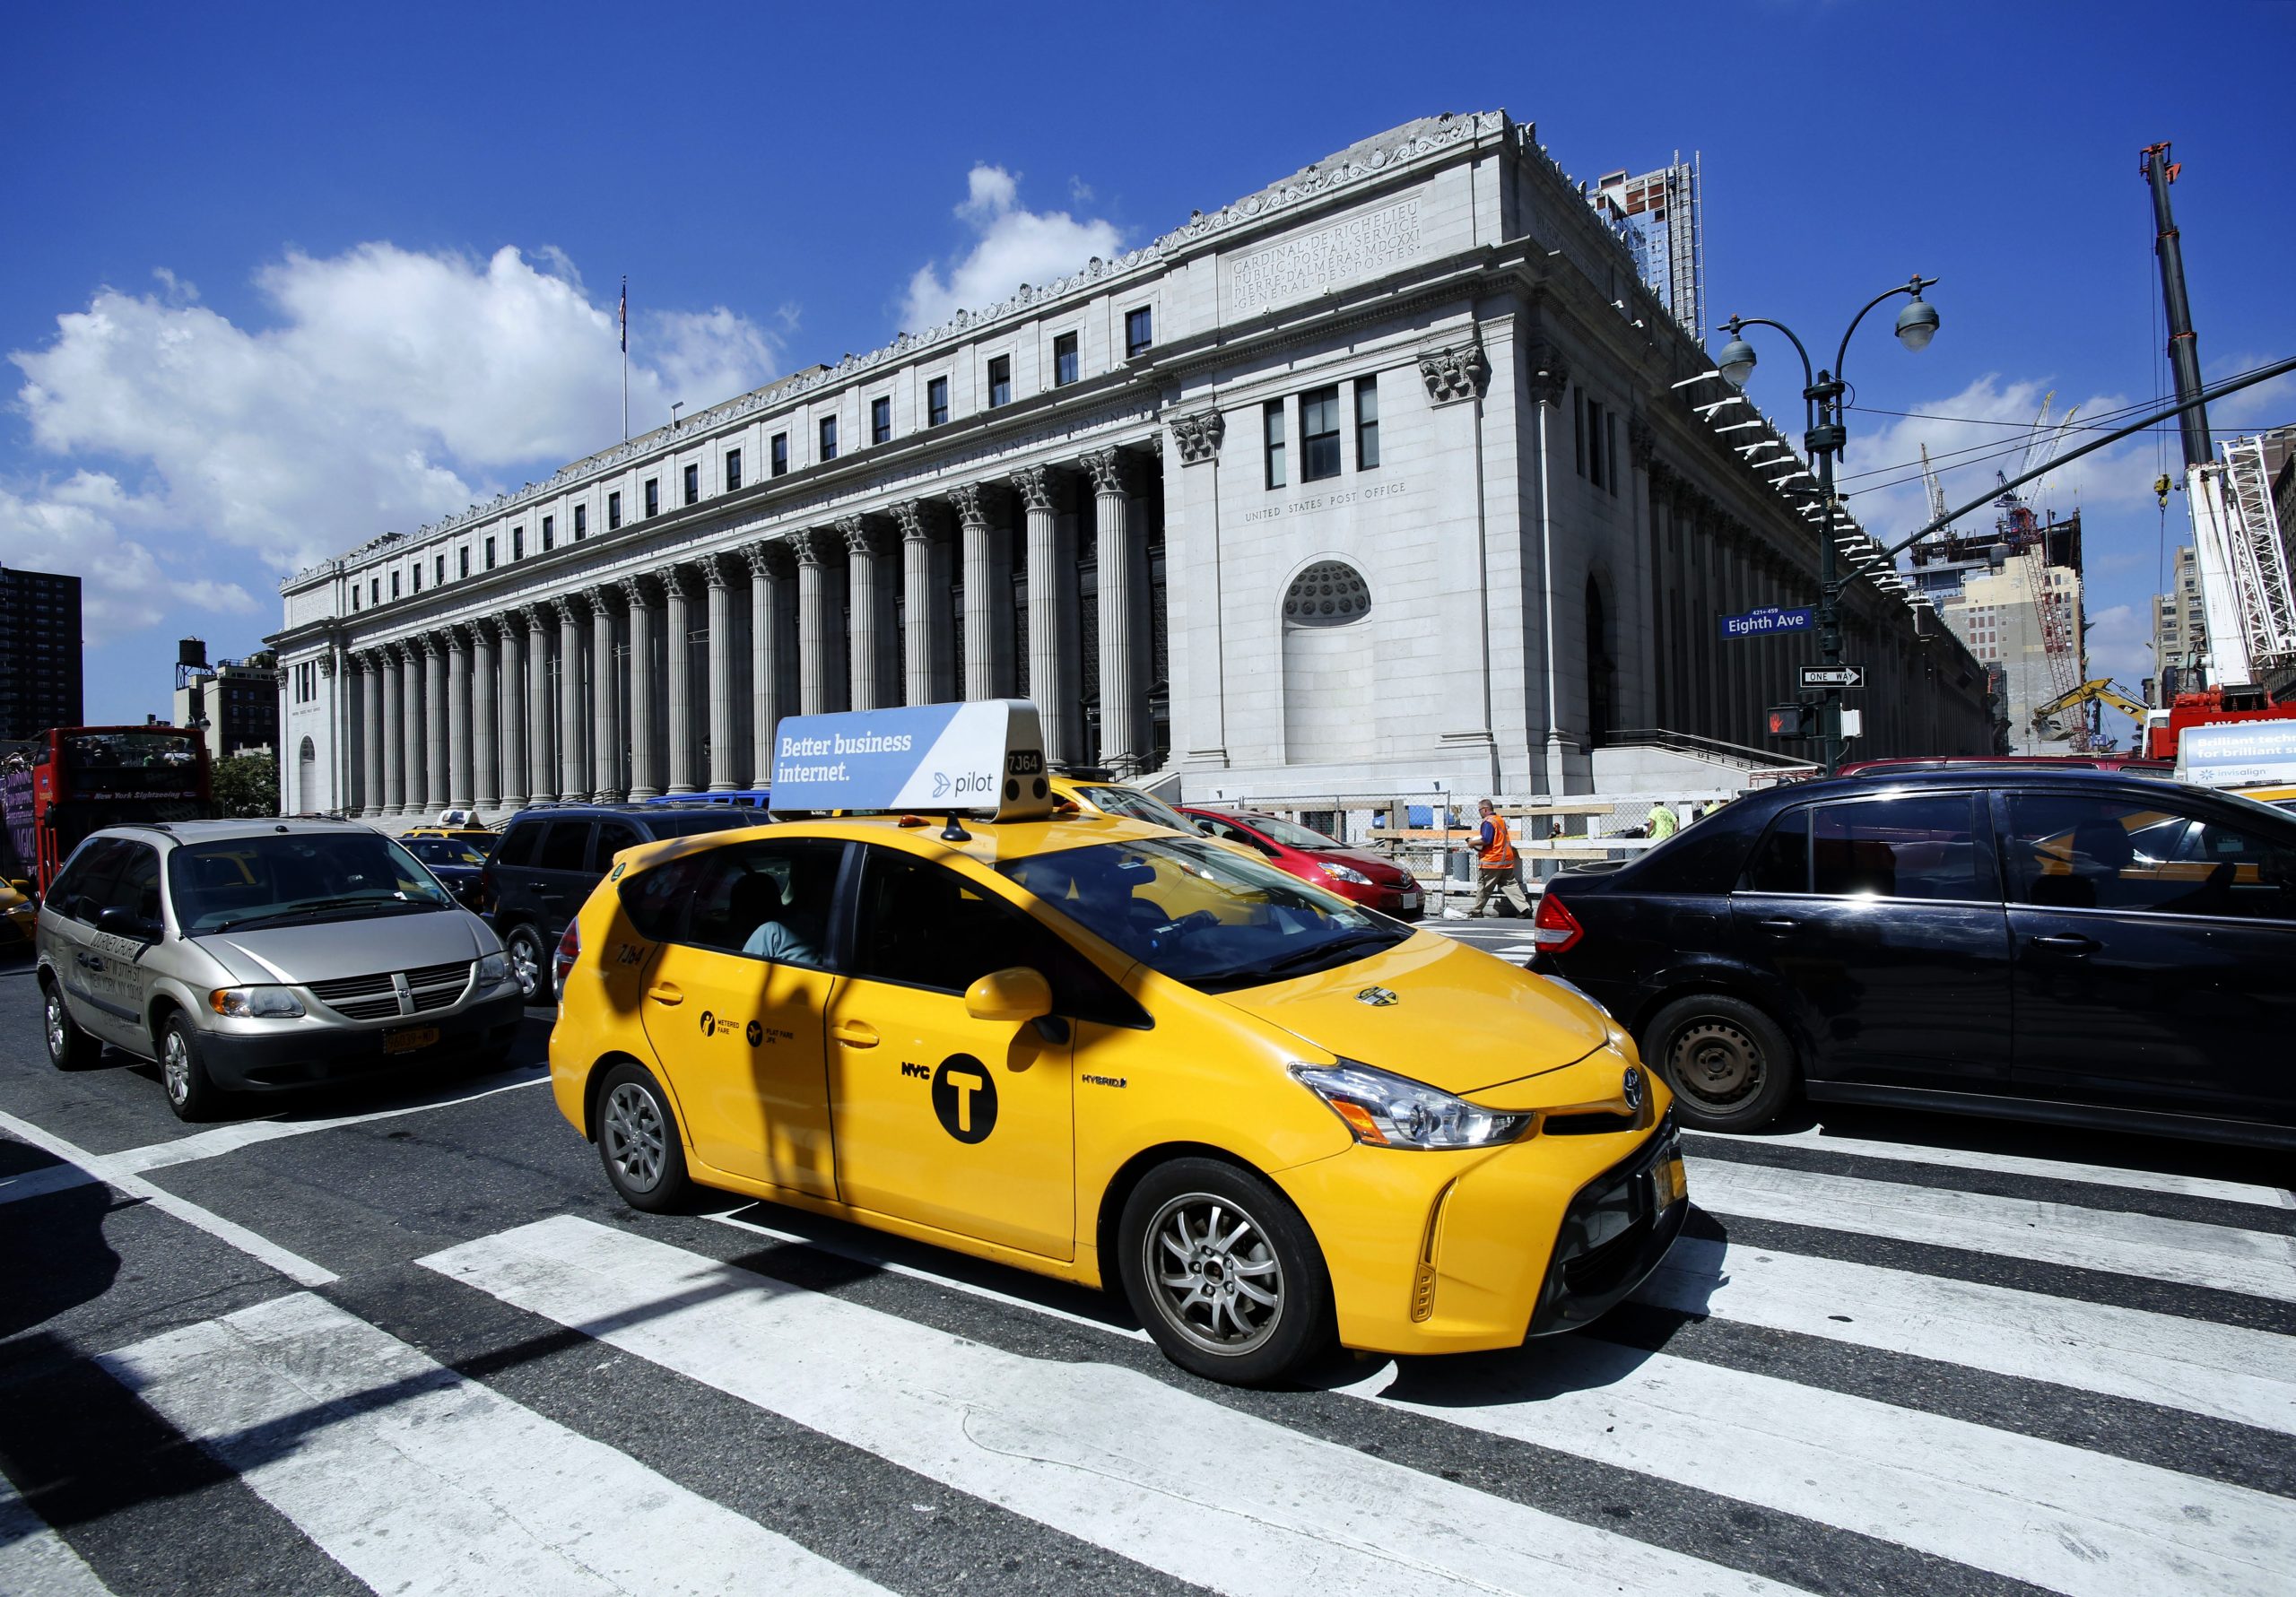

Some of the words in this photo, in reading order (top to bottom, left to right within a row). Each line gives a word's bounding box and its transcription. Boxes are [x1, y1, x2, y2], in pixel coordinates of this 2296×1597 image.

[1234, 240, 1305, 273] CARDINAL
[1311, 233, 1327, 250] DE
[1335, 204, 1417, 238] RICHELIEU
[1235, 260, 1287, 287] PUBLIC
[1293, 242, 1348, 268] POSTAL
[1354, 217, 1418, 247] SERVICE
[1235, 275, 1281, 299] PIERRE
[1365, 229, 1420, 257] MDCXXI
[1239, 282, 1309, 308] GENERAL
[1318, 265, 1346, 284] DES
[1354, 245, 1414, 273] POSTES
[904, 460, 953, 483] THEIR
[961, 430, 1057, 464] APPOINTED
[1067, 403, 1149, 438] ROUNDS
[1246, 507, 1281, 522] UNITED
[1288, 499, 1322, 513] STATES
[1330, 492, 1357, 506] POST
[1365, 482, 1405, 499] OFFICE
[1728, 617, 1772, 634] Eighth
[1777, 614, 1805, 627] Ave
[1810, 673, 1828, 681] ONE
[1836, 673, 1854, 681] WAY
[780, 736, 831, 758] Better
[834, 731, 912, 756] business
[2197, 735, 2255, 747] Brilliant
[2197, 750, 2220, 759] for
[2223, 746, 2282, 757] brilliant
[778, 761, 851, 784] internet.
[2218, 768, 2266, 777] invisalign
[955, 771, 993, 797] pilot
[134, 791, 180, 801] Sightseeing
[133, 966, 142, 983] ST
[718, 1019, 739, 1029] METERED
[718, 1026, 730, 1035] FARE
[901, 1062, 930, 1080] NYC
[1082, 1073, 1119, 1088] HYBRID
[946, 1070, 983, 1133] T
